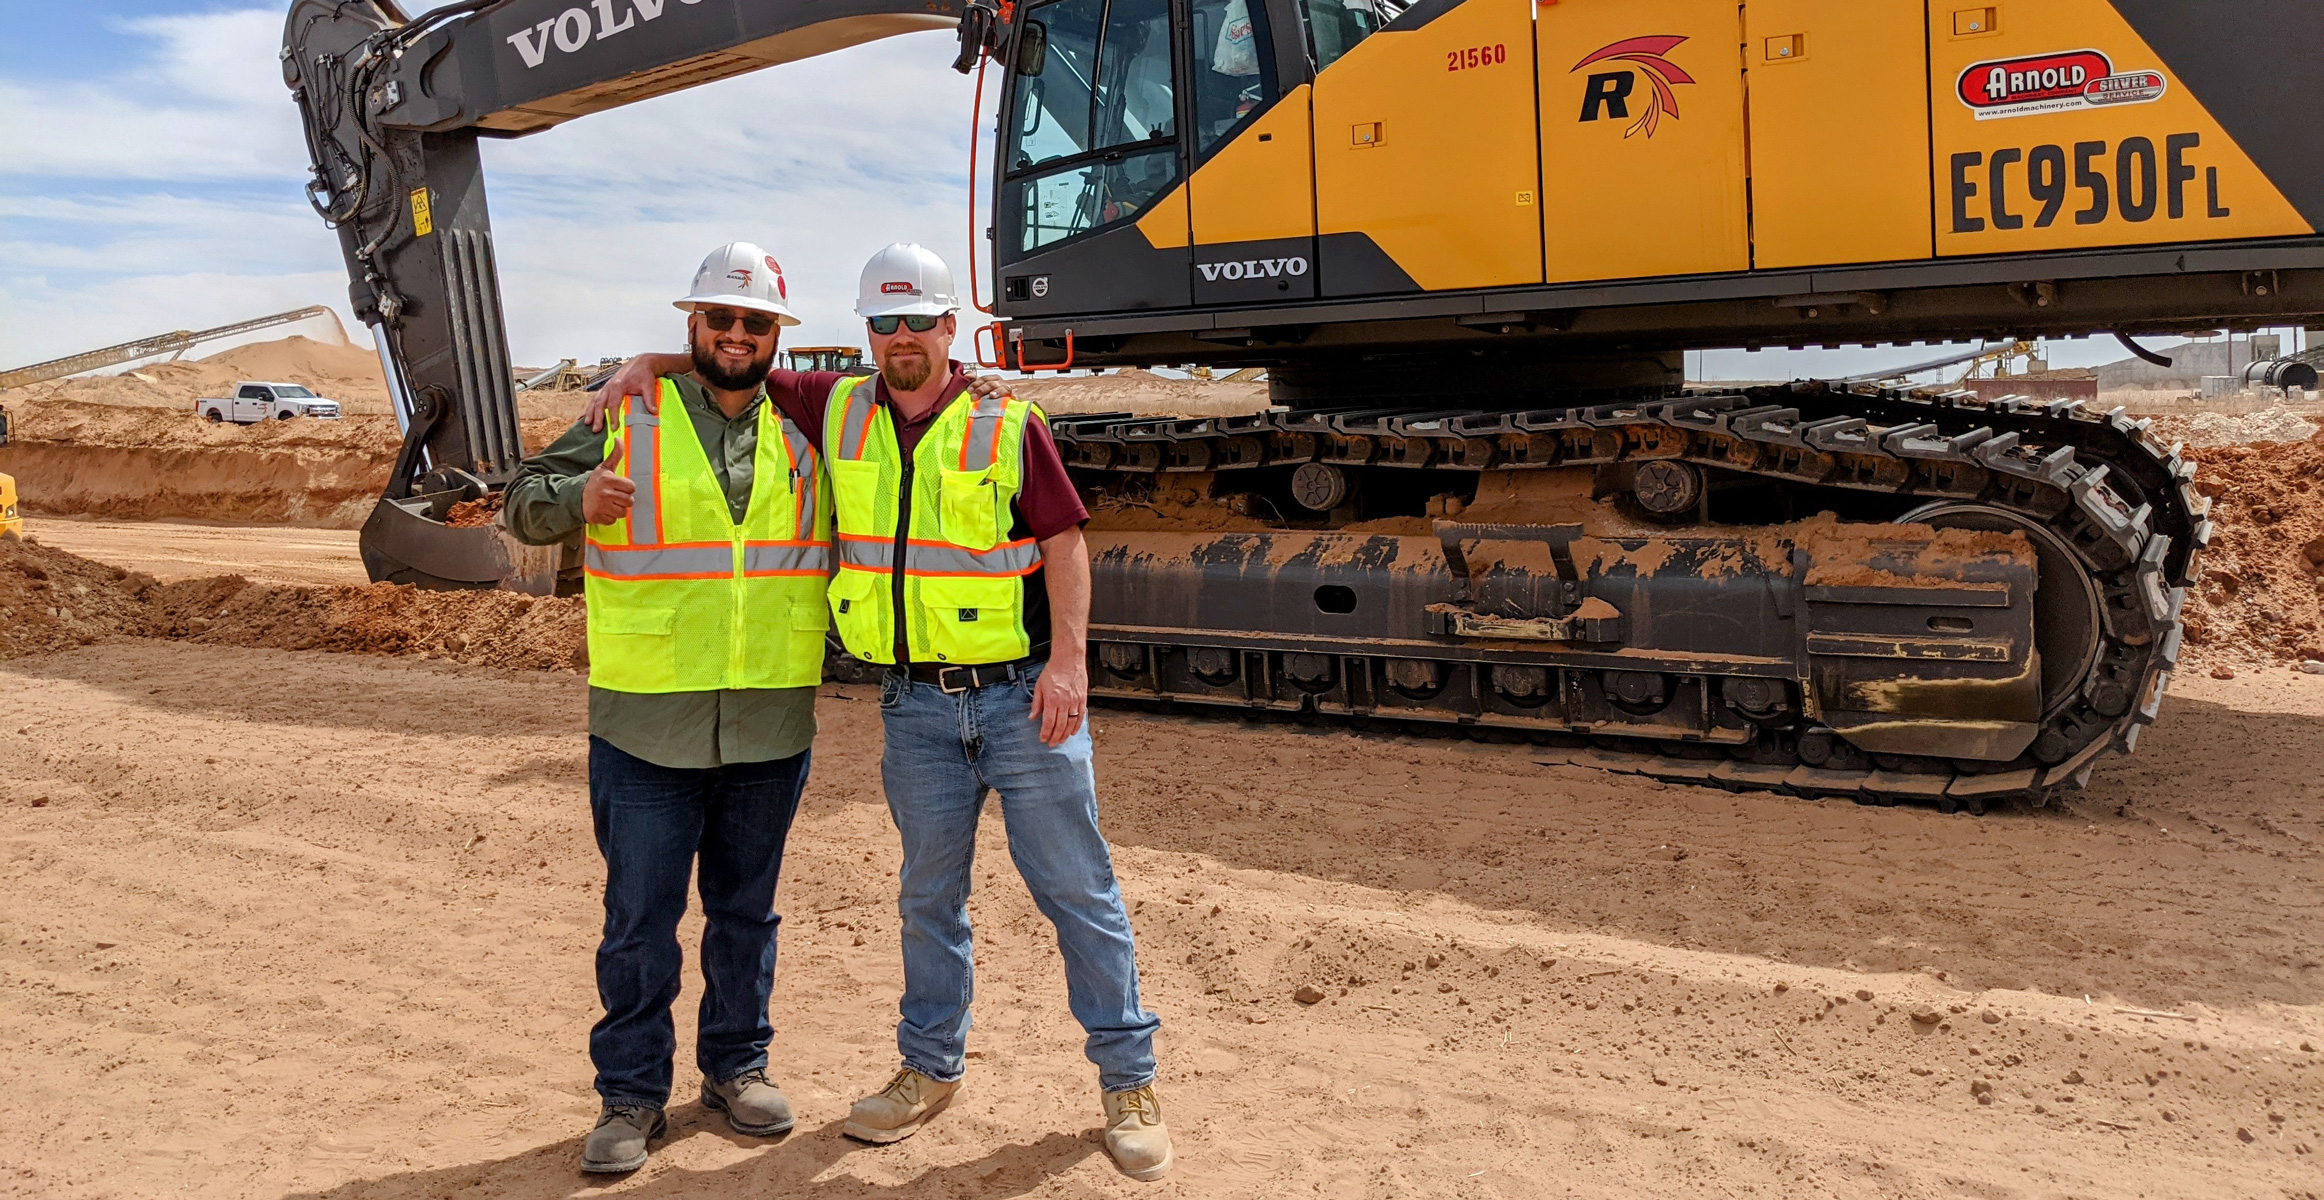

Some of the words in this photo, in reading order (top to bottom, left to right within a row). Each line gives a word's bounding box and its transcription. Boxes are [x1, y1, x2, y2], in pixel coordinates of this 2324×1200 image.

[507, 0, 703, 68] VOL
[1447, 43, 1506, 72] 21560
[1985, 65, 2086, 99] ARNOLD
[2099, 75, 2149, 92] SILVER
[2102, 89, 2145, 99] SERVICE
[1578, 70, 1635, 122] R
[1978, 100, 2082, 117] www.arnoldmachinery.com
[1197, 257, 1308, 281] VOLVO
